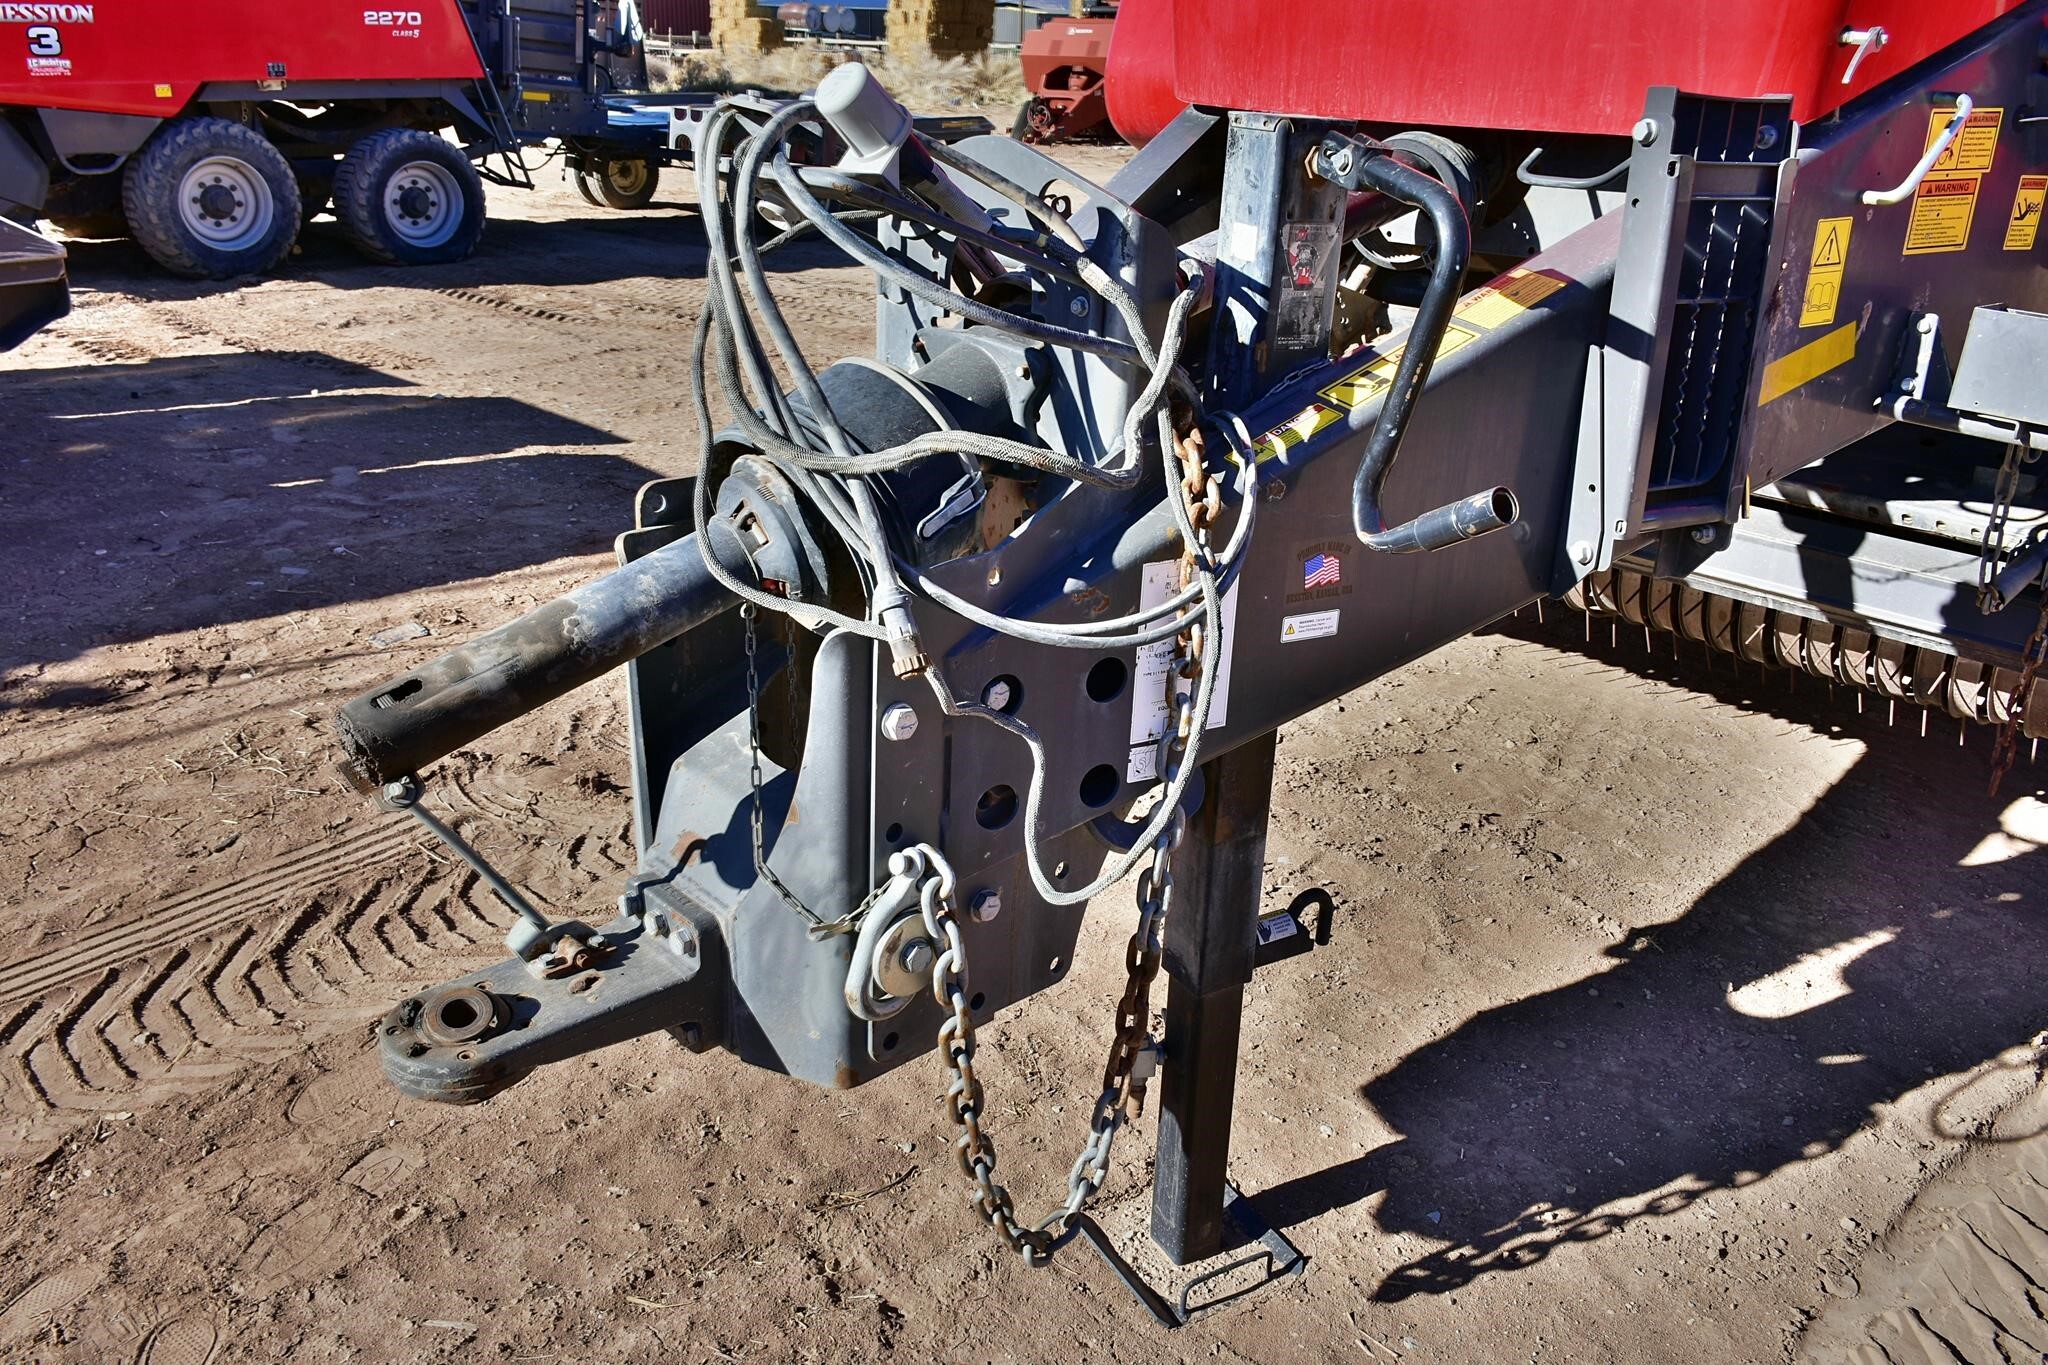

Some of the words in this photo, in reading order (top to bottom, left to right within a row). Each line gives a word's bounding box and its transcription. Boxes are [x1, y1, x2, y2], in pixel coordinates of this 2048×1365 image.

[363, 11, 422, 26] 2270
[27, 25, 62, 56] 3
[1973, 115, 1999, 123] WARNING
[1934, 182, 1970, 193] WARNING
